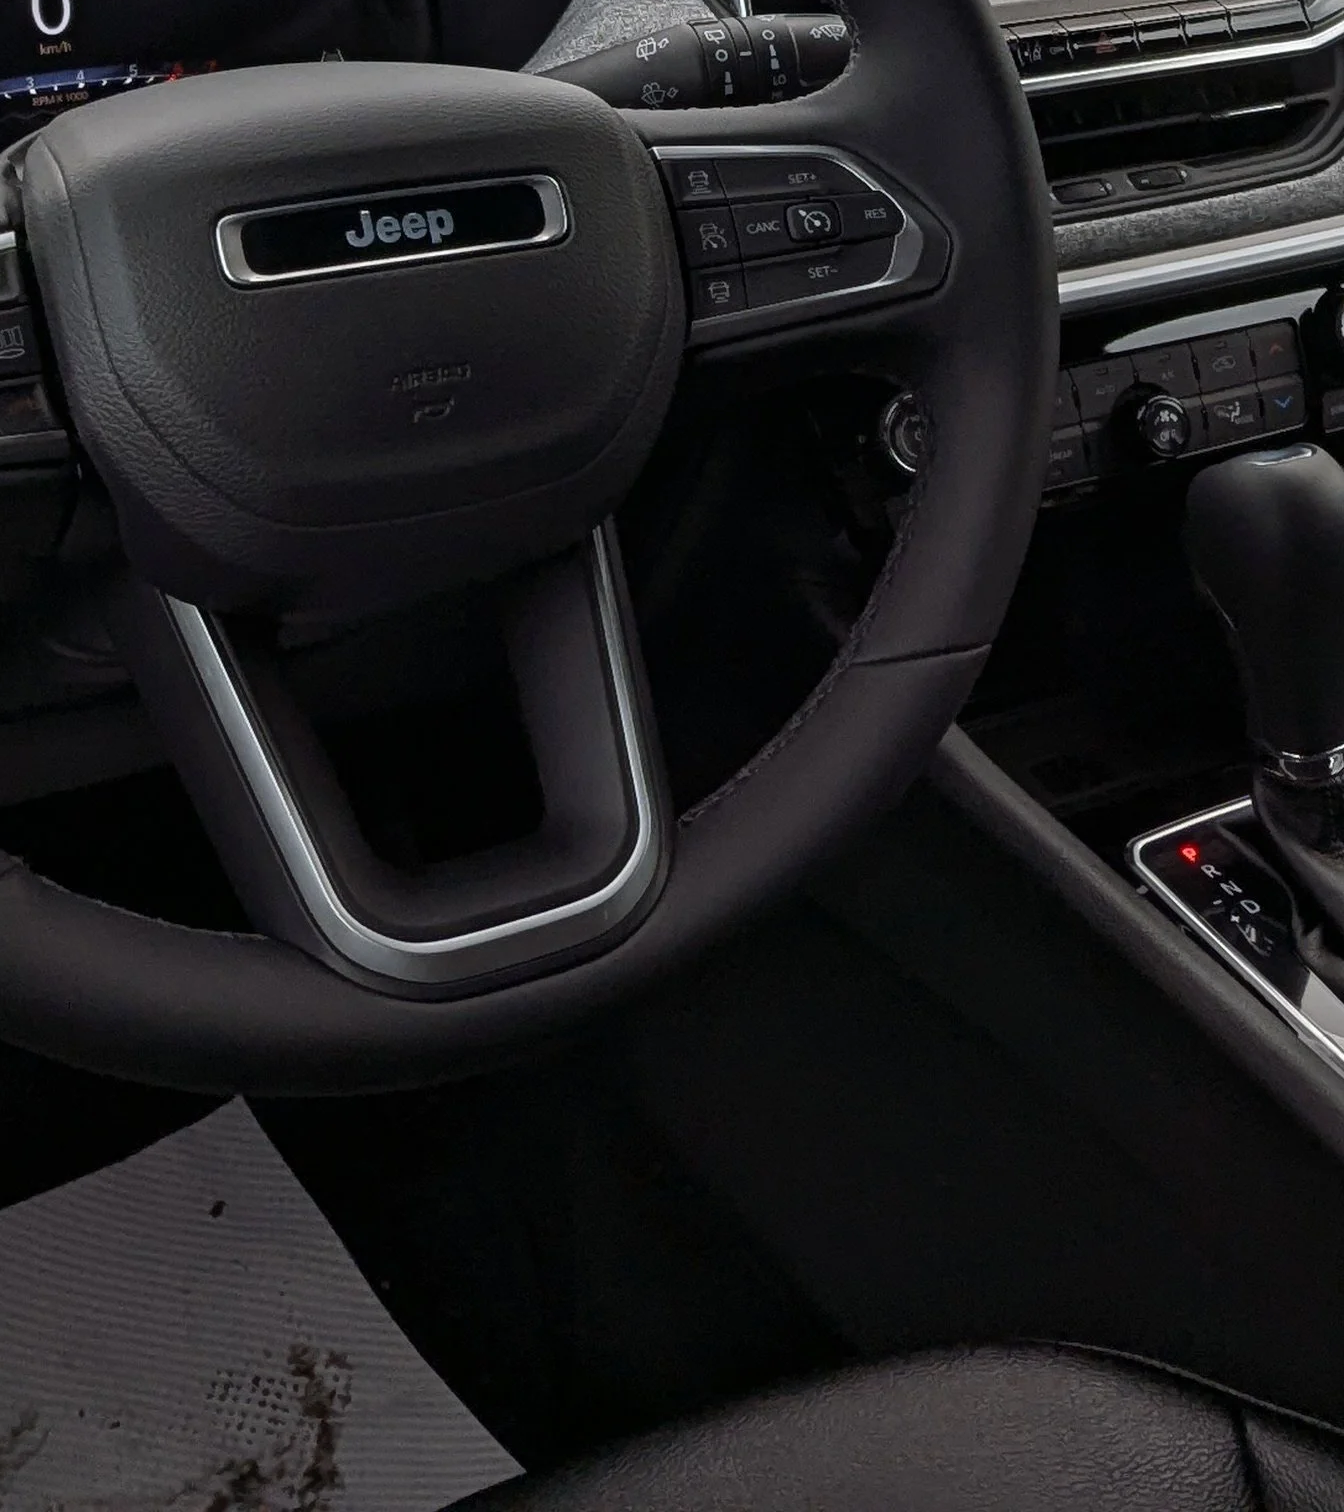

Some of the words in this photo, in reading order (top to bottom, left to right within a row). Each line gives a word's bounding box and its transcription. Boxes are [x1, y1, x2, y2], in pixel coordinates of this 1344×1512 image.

[39, 40, 72, 56] km/h
[25, 76, 35, 89] 3
[76, 69, 85, 81] 4
[129, 64, 138, 77] 5
[772, 73, 787, 87] LO
[32, 94, 55, 107] RPM
[65, 90, 89, 103] 1000
[787, 172, 817, 185] SET+
[864, 207, 887, 220] RES
[345, 208, 455, 248] Jeep
[746, 220, 781, 234] CANC
[1181, 847, 1197, 864] P
[1200, 863, 1223, 879] R
[1219, 879, 1244, 896] N
[1239, 899, 1261, 914] D
